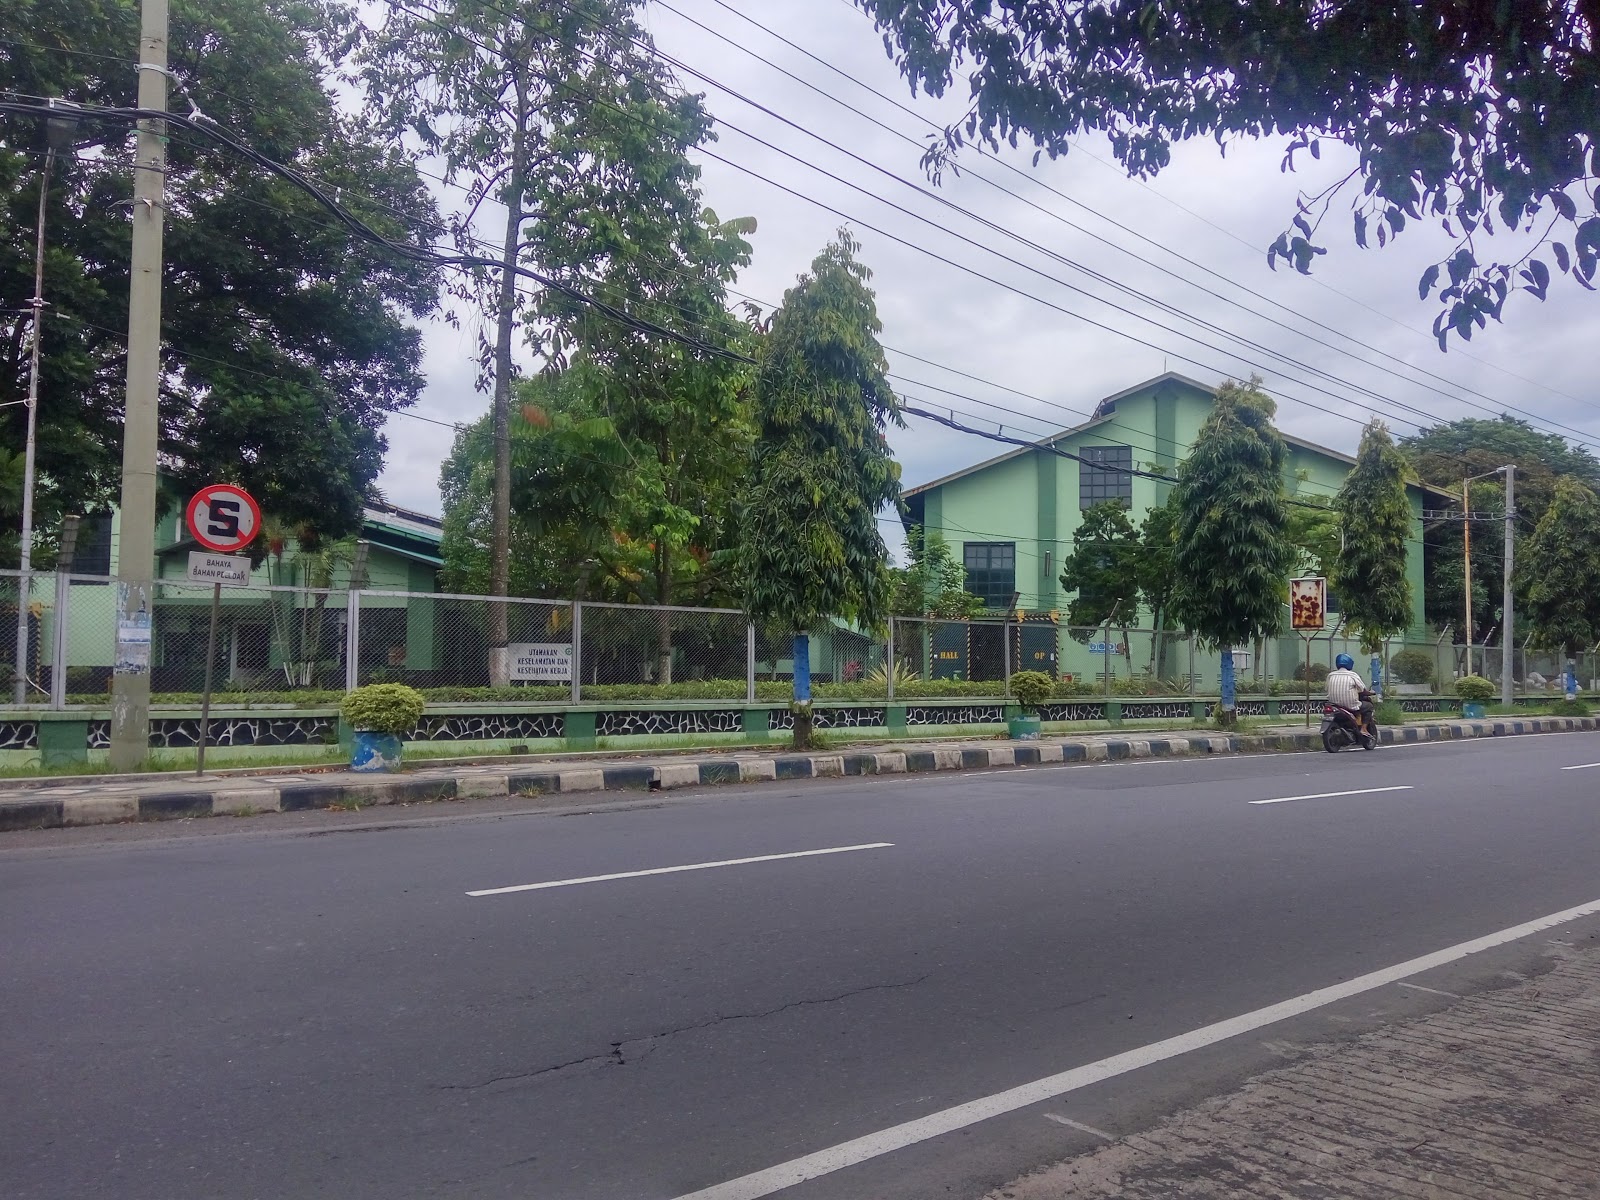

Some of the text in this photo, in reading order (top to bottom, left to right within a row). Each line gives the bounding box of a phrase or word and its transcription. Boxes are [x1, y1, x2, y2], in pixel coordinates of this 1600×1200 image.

[207, 499, 240, 538] S
[206, 558, 232, 569] BAHAYA
[192, 567, 216, 578] BAHAN
[528, 648, 558, 656] UTAMAKAN
[940, 651, 959, 660] HALL
[517, 657, 556, 665] KESELAMATAN
[517, 667, 568, 675] KESEHATAN KERJA
